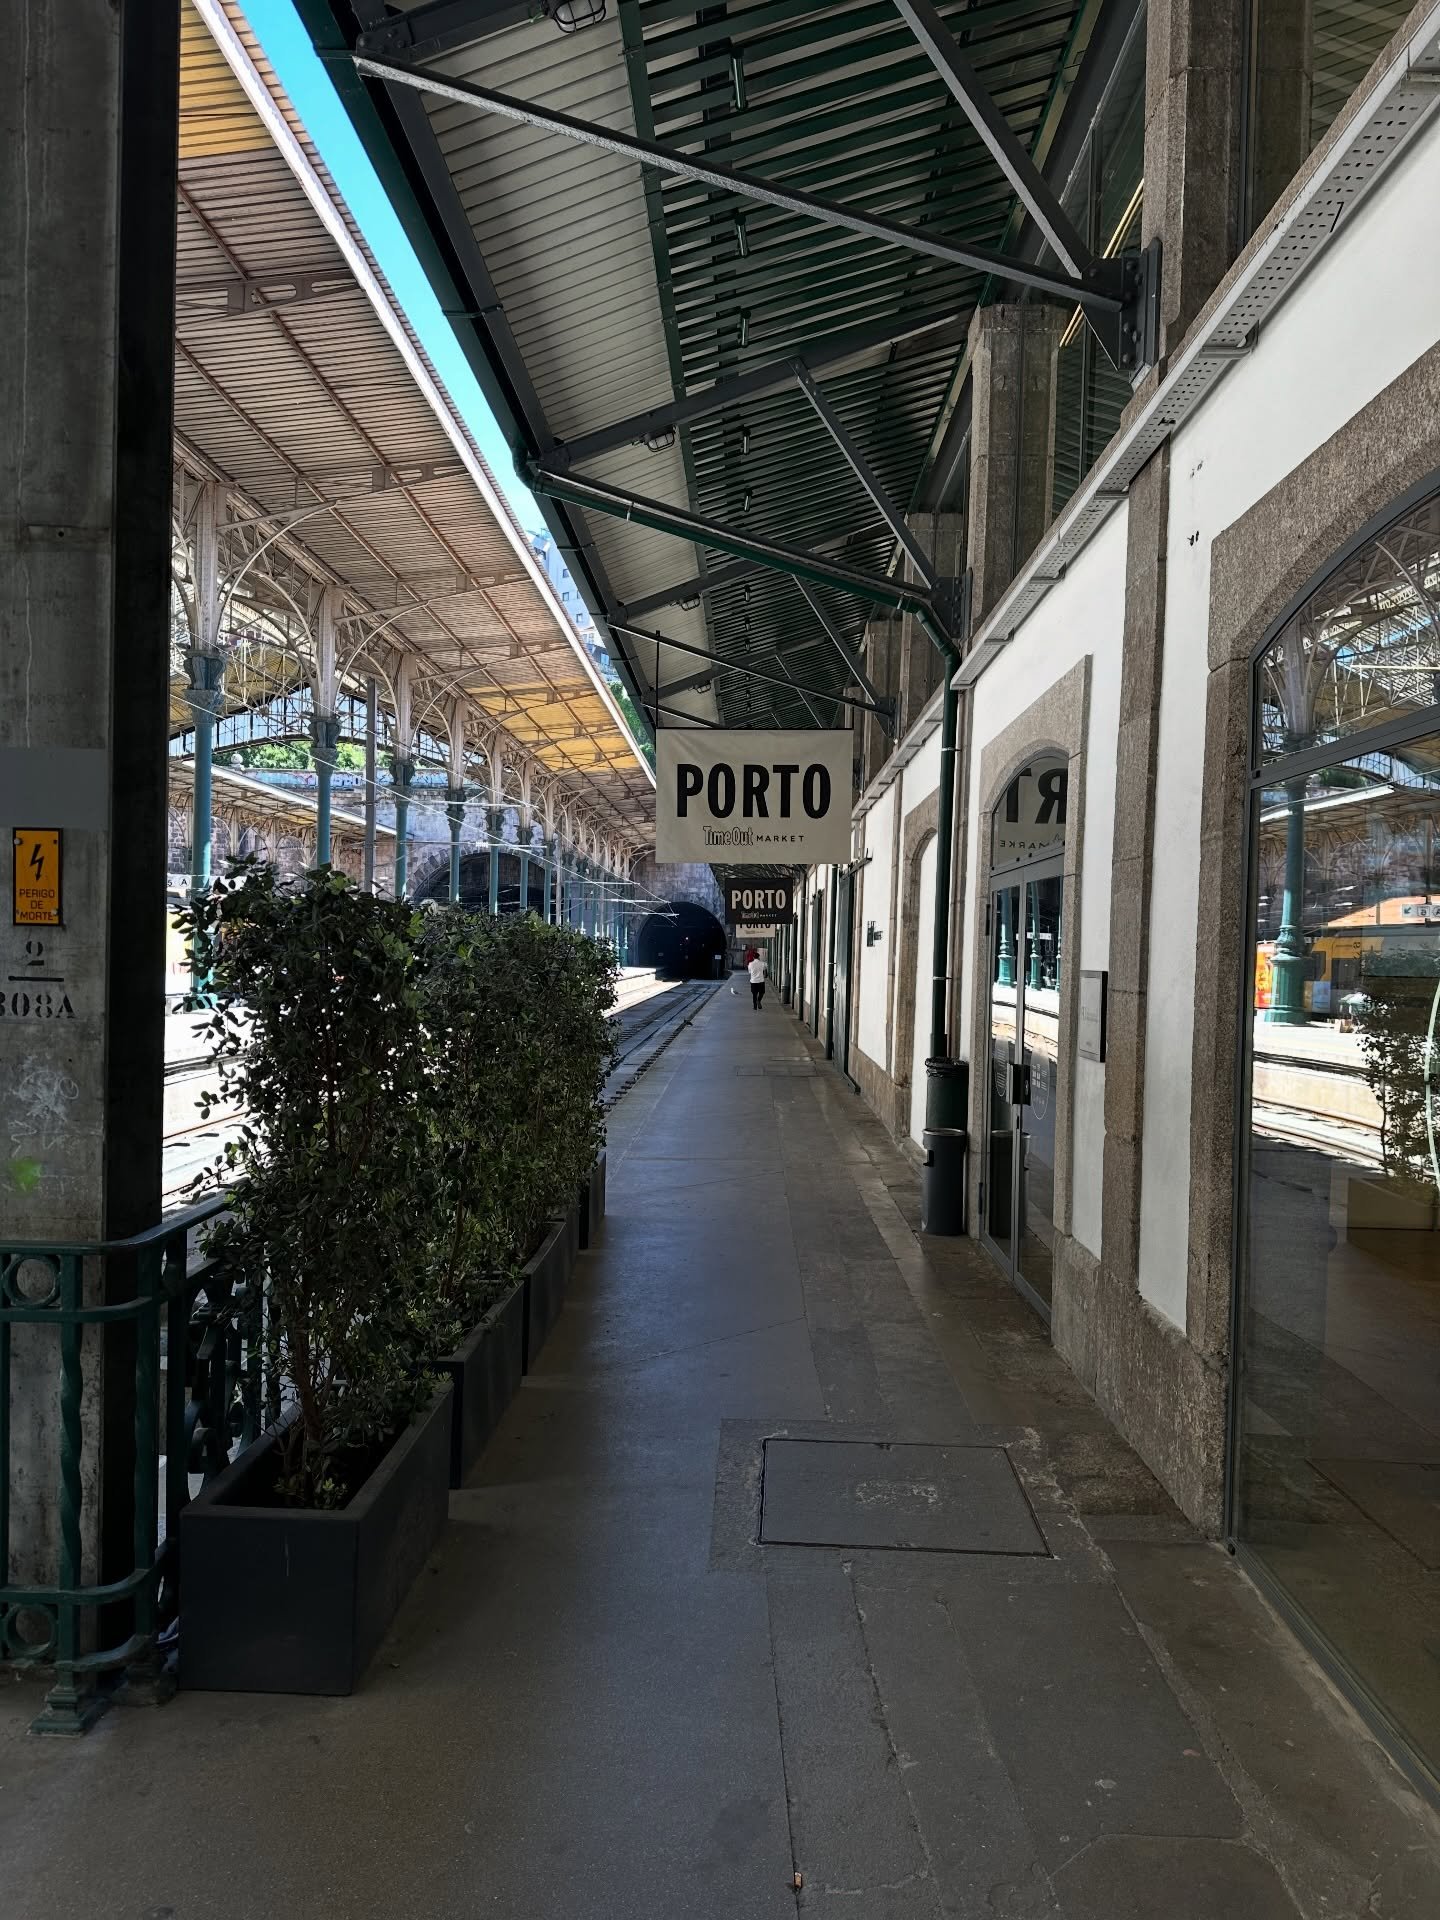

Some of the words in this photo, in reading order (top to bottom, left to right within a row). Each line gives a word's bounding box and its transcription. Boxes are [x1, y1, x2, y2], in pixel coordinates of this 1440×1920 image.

[677, 762, 831, 819] PORTO
[756, 834, 805, 843] MARKET
[19, 888, 56, 899] PERIGO
[30, 900, 44, 910] DE
[731, 889, 787, 910] PORTO
[19, 911, 54, 921] MORTE
[25, 940, 45, 966] 2
